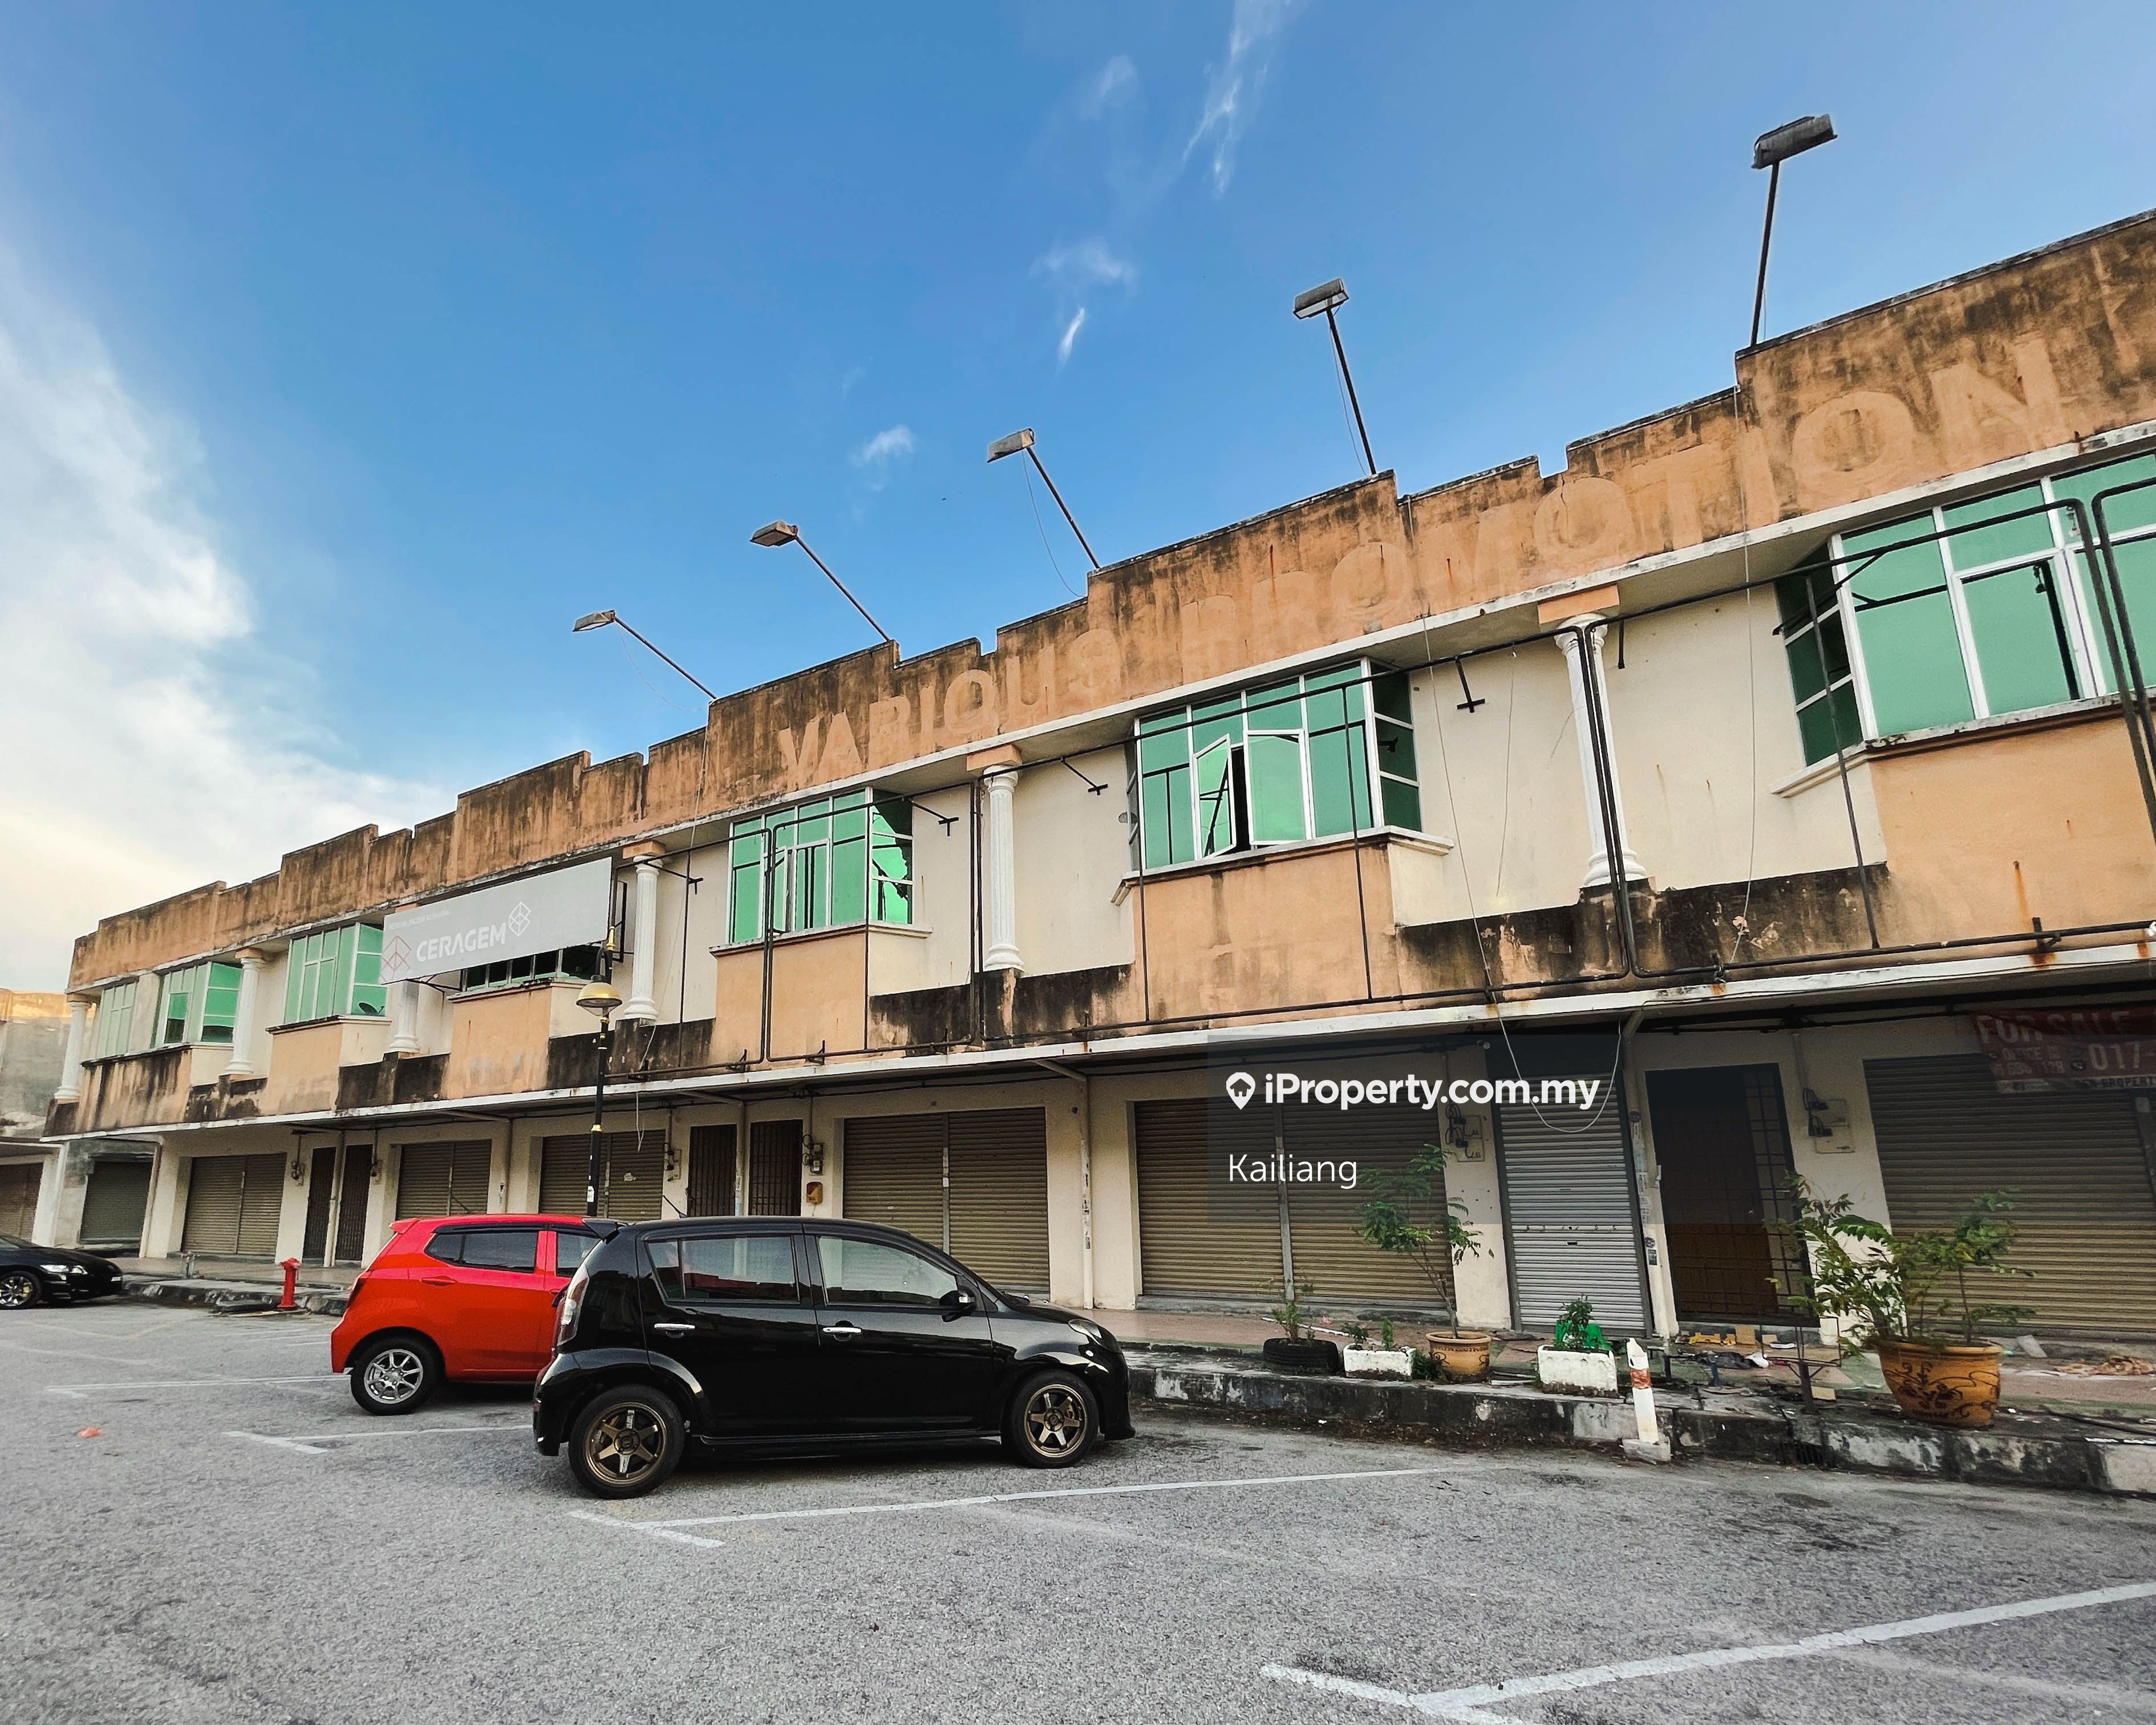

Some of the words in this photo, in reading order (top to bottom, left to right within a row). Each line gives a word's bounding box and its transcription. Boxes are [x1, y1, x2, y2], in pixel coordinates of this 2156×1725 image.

[779, 629, 1122, 792] VARIOUS
[1180, 332, 2073, 685] PROMOTION
[417, 923, 506, 962] CERAGEM
